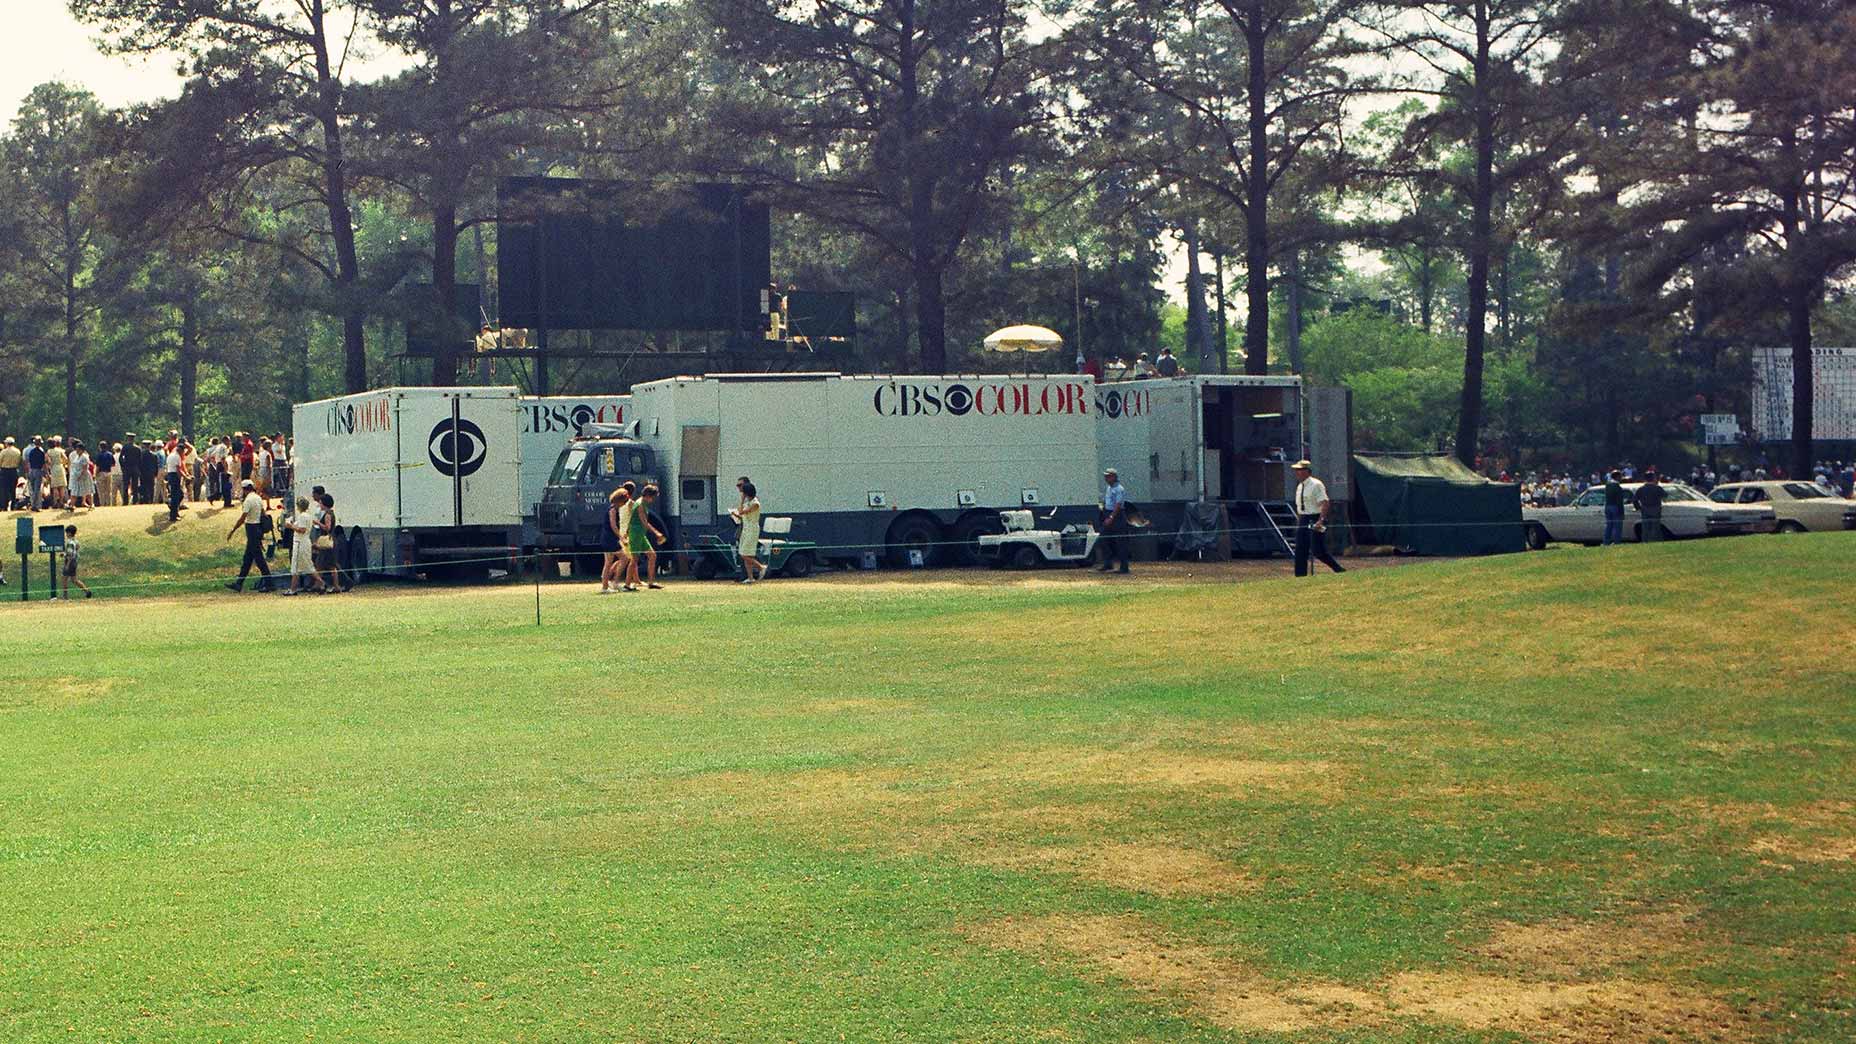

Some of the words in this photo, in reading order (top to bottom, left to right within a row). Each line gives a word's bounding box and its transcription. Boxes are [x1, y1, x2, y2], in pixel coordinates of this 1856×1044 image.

[874, 384, 942, 416] CBS
[976, 383, 1088, 416] COLOR
[327, 404, 347, 435] CBS
[354, 399, 391, 432] COLOR
